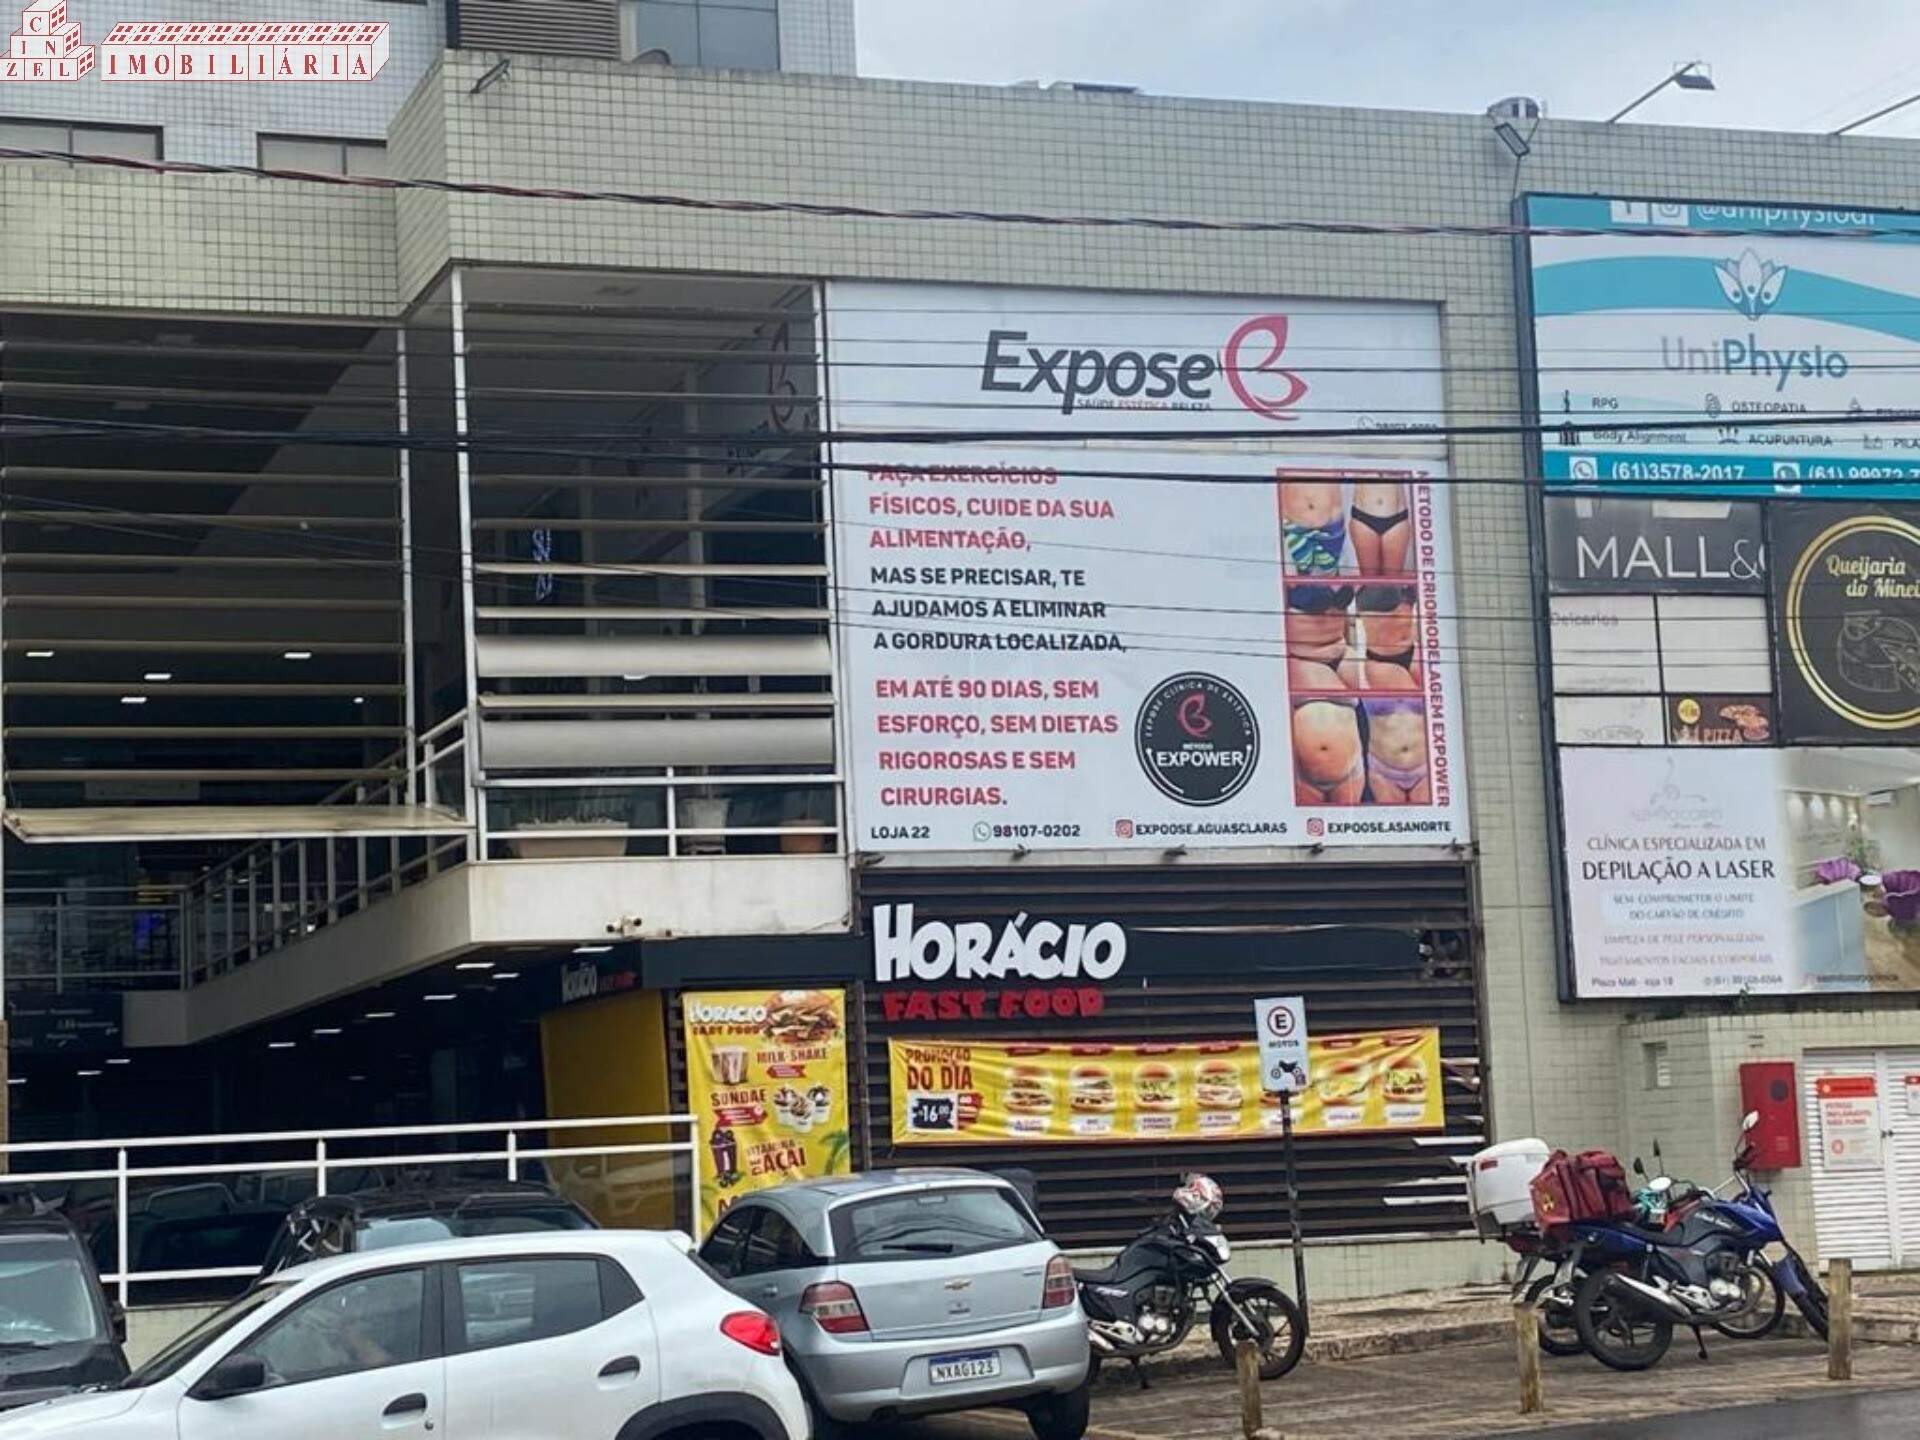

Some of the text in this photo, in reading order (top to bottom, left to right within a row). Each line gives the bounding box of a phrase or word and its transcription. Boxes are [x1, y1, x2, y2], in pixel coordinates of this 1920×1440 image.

[981, 330, 1216, 415] Expose
[869, 492, 1114, 519] FÍSICOS, CUIDE DA SUA
[869, 527, 1032, 554] ALIMENTAÇÃO,
[1576, 535, 1765, 580] MALL&
[1826, 554, 1906, 580] Queijaria
[870, 567, 1086, 588] MAS SE PRECISAR, TE
[1845, 579, 1869, 597] do
[872, 600, 988, 618] AJUDAMOS
[1010, 601, 1107, 619] ELIMINAR
[873, 632, 1127, 653] A GORDURA LOCALIZADA,
[876, 675, 1099, 701] EM ATÉ 90 DIAS, SEM
[1421, 545, 1436, 568] DE
[1431, 722, 1450, 807] EXPOWER
[877, 715, 1119, 739] ESFORÇO, SEM DIETAS
[879, 751, 1076, 769] RIGOROSAS E SEM
[1156, 751, 1244, 766] EXPOWER
[880, 787, 1008, 806] CIRURGIAS.
[871, 826, 931, 840] LOJA 22
[992, 823, 1081, 839] 98107-0202
[1587, 834, 1767, 851] CLÍNICA ESPECIALIZADA EM
[1582, 856, 1776, 885] DEPILAÇÃO A LASER
[872, 902, 1128, 983] HORÁCIO
[882, 987, 1105, 1022] FAST FOOD
[1274, 1013, 1288, 1030] E
[906, 1065, 974, 1090] DO DIA
